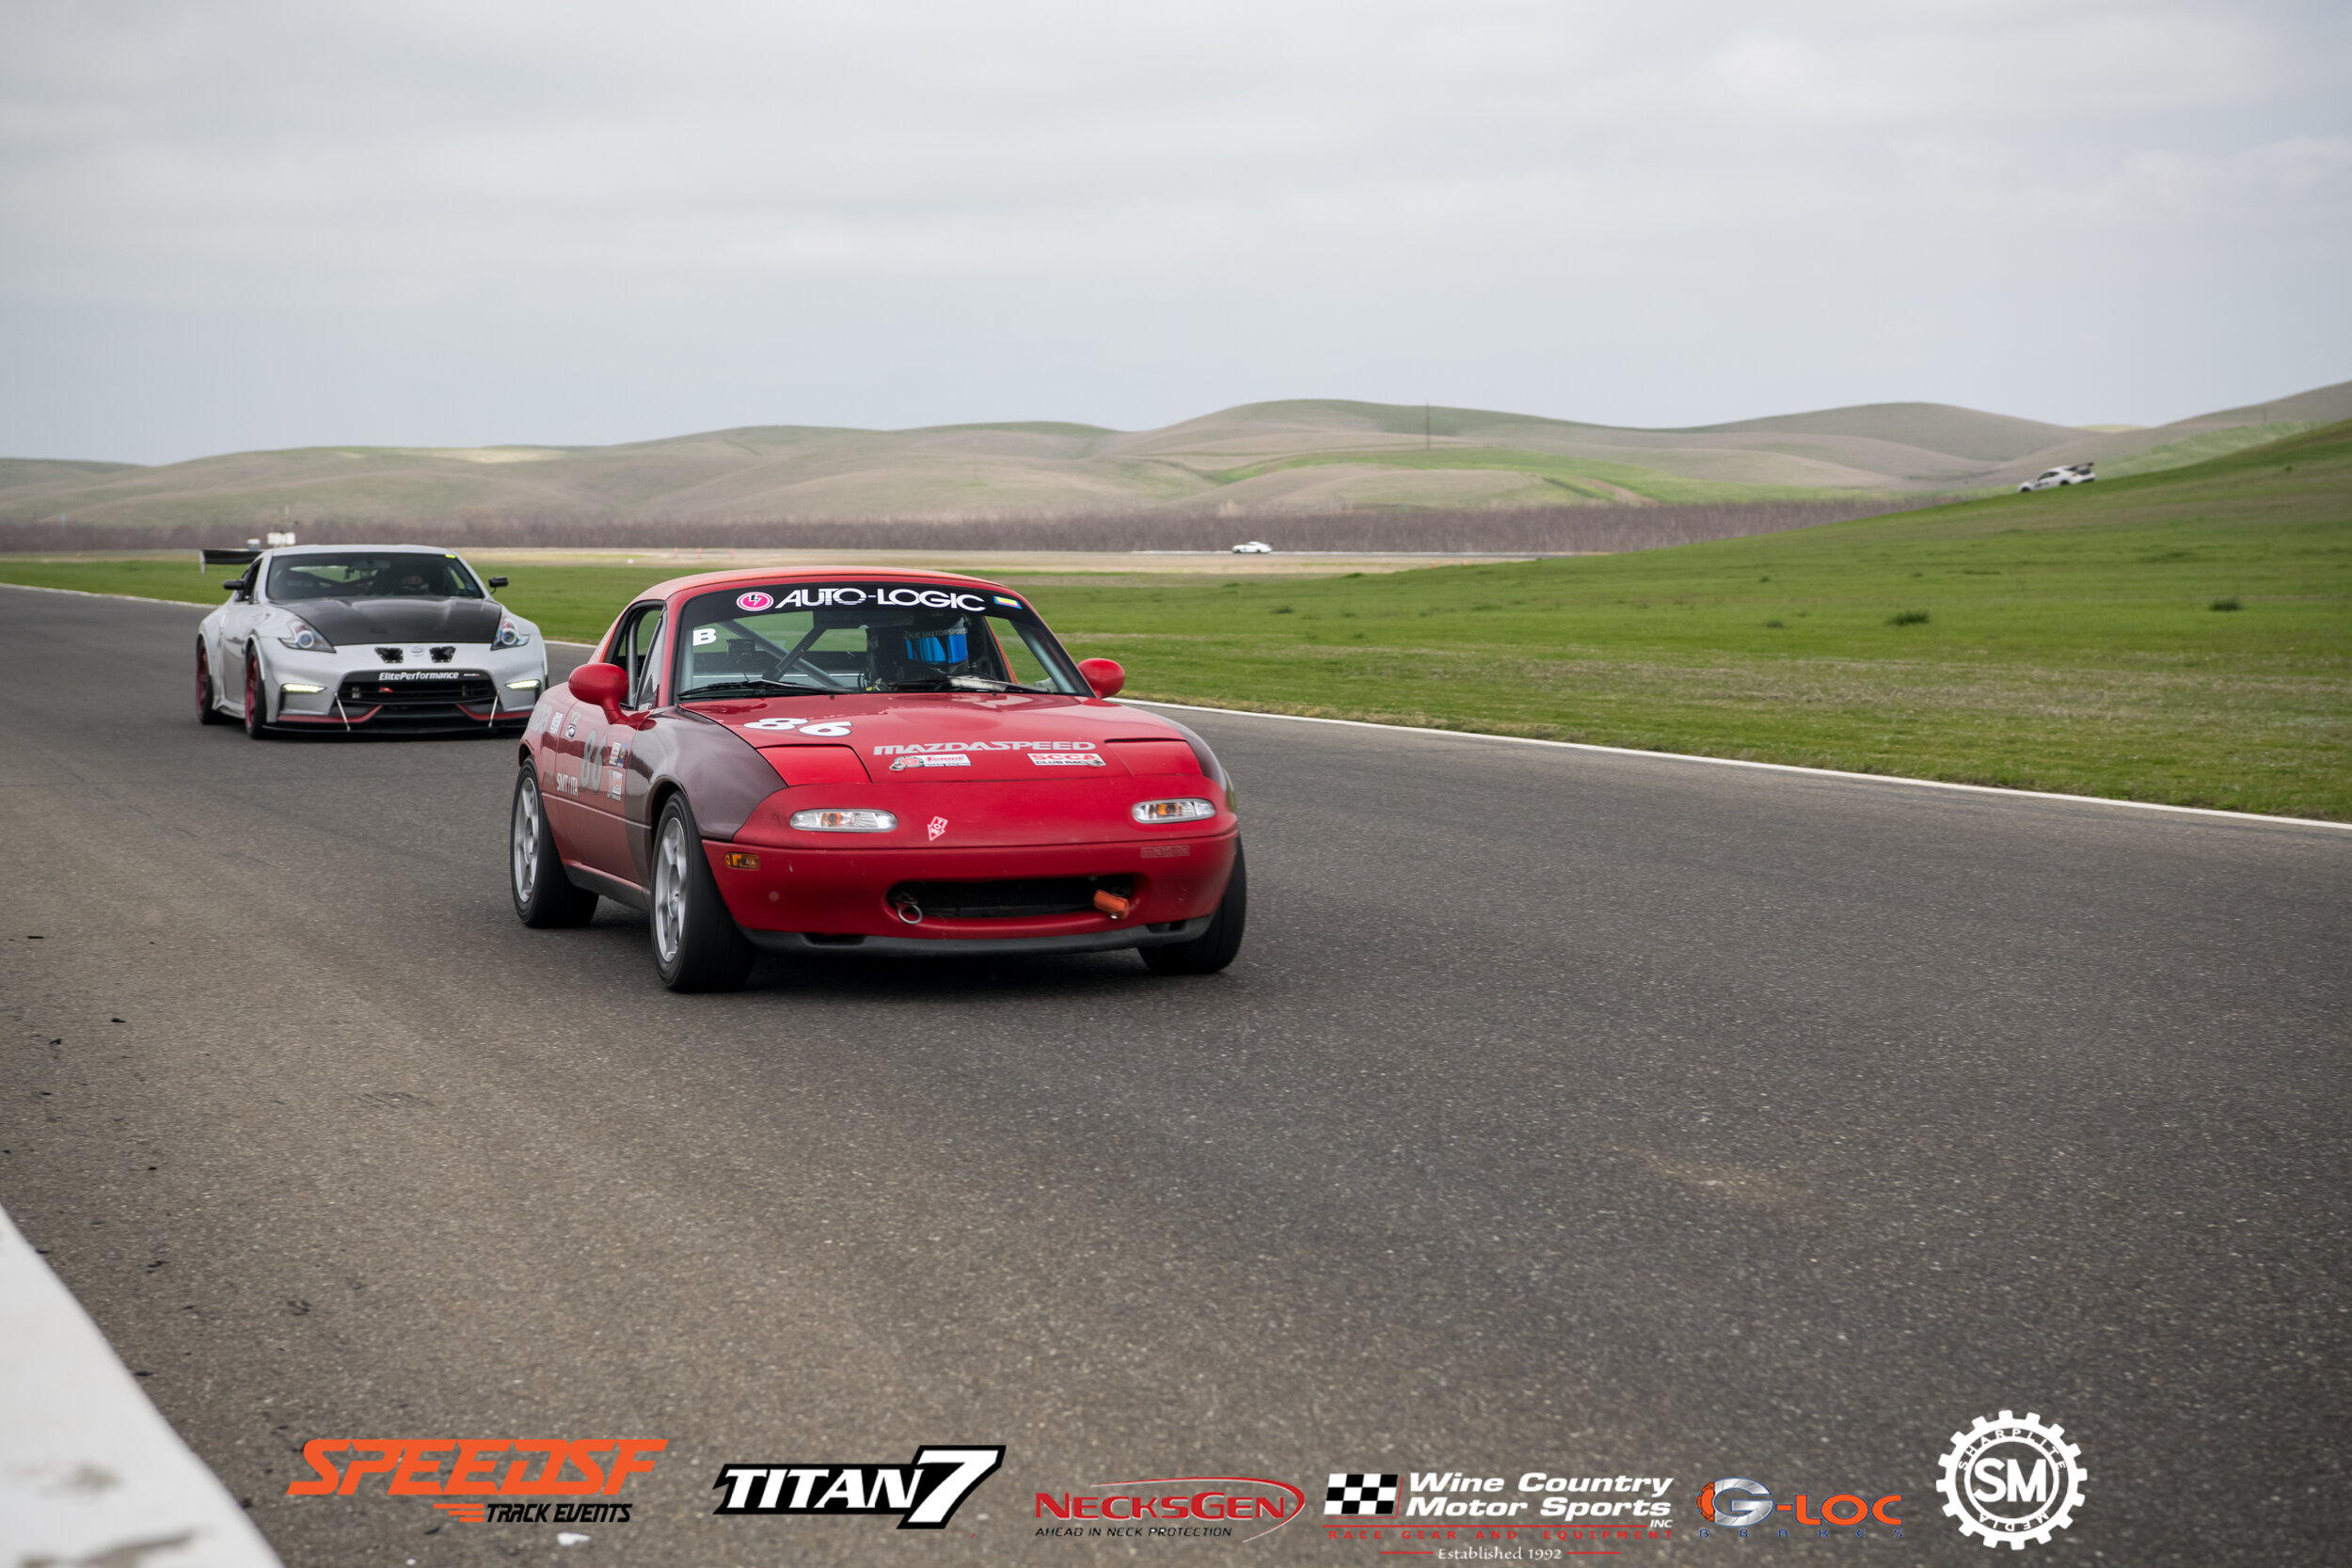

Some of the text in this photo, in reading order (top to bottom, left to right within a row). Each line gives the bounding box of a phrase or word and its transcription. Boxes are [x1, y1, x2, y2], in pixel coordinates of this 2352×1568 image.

[774, 588, 987, 611] AUTO-LOGIC
[692, 627, 717, 646] B
[378, 671, 459, 681] ElitePerformance
[743, 717, 853, 737] 86
[873, 740, 1096, 755] MAZDASPEED
[580, 729, 609, 795] 86
